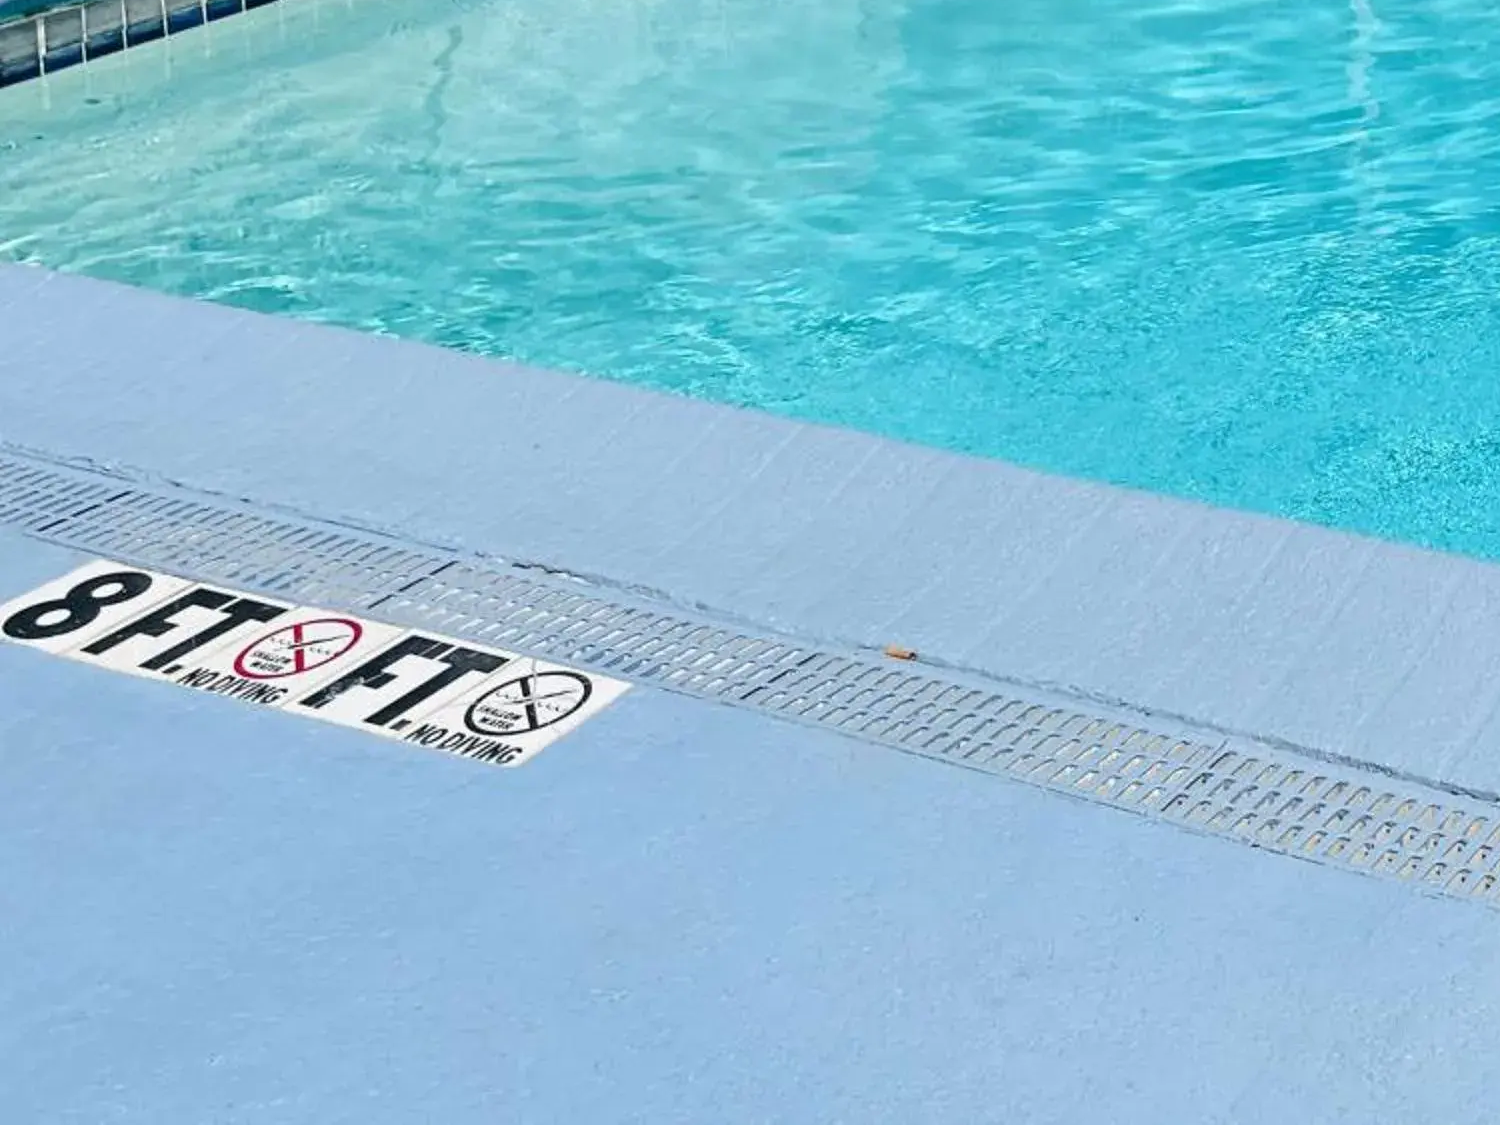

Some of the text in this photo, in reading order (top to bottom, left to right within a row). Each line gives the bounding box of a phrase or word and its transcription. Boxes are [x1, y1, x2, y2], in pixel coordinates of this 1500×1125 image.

[3, 572, 153, 639] 8
[176, 666, 288, 703] NO DIVING
[403, 723, 523, 764] NO DIVING
